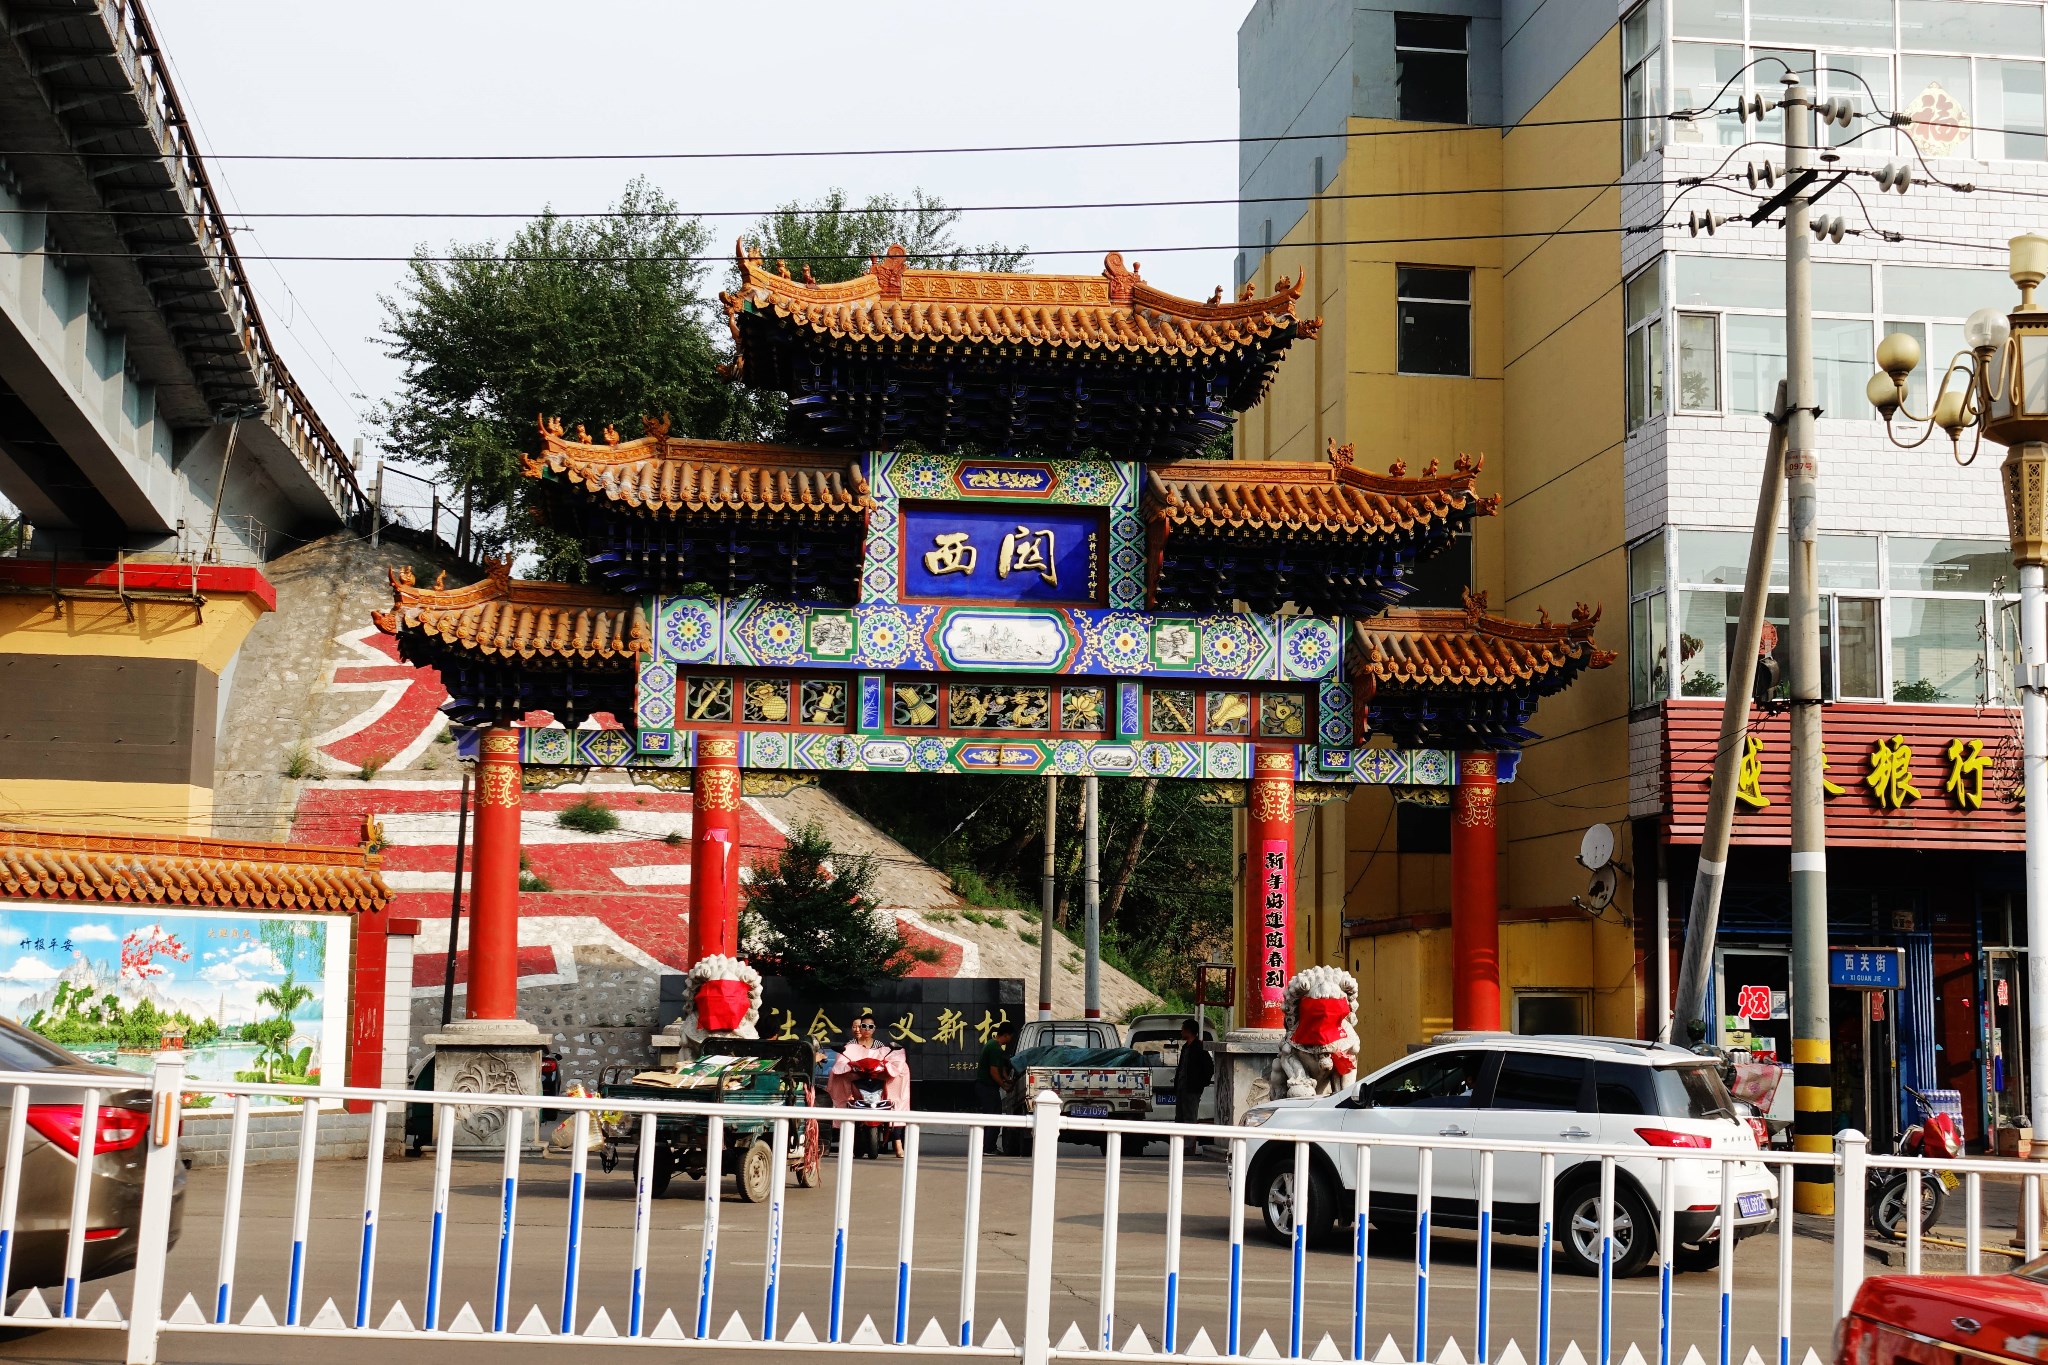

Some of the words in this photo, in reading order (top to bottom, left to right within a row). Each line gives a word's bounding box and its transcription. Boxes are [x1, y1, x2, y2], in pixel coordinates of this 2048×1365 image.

[1911, 94, 1959, 142] 福
[20, 937, 74, 952] 竹报平安
[1845, 954, 1886, 973] 西关街
[1738, 985, 1771, 1020] 烟
[770, 1007, 1011, 1050] 社会义新村
